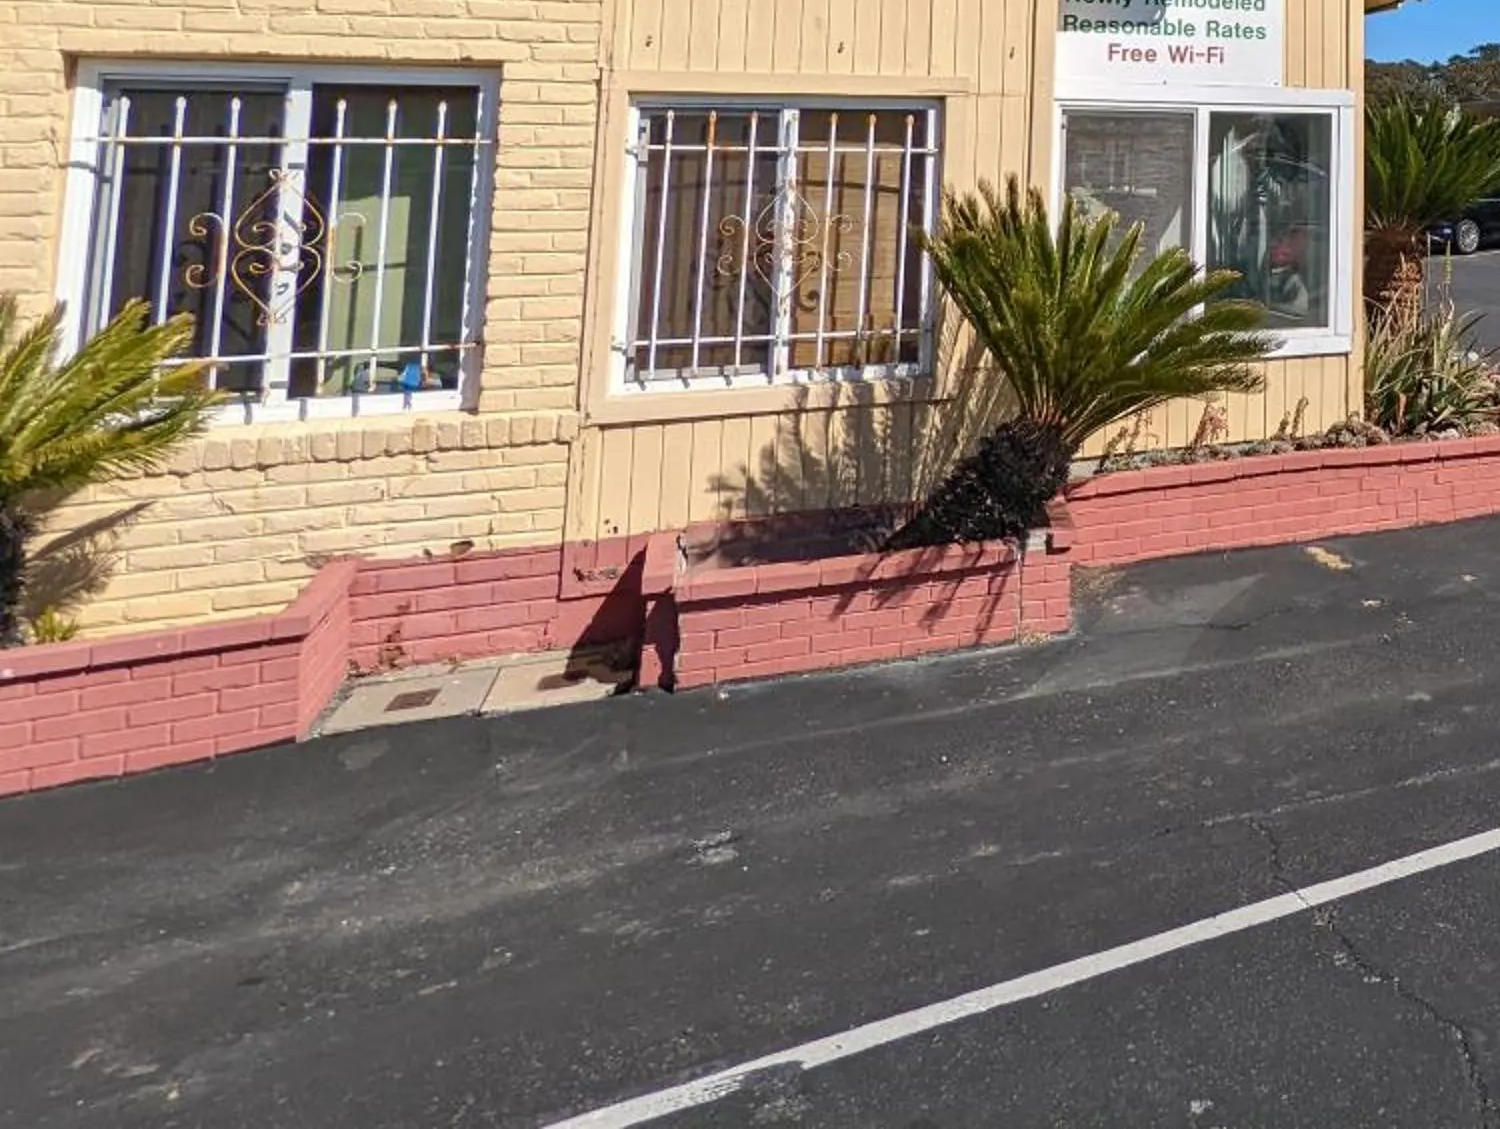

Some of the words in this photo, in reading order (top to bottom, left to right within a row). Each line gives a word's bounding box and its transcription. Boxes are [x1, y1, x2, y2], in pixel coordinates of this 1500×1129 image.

[1063, 13, 1196, 38] Reasonable
[1206, 20, 1267, 40] Rates
[1107, 42, 1158, 64] Free
[1168, 44, 1225, 65] Wi-Fi
